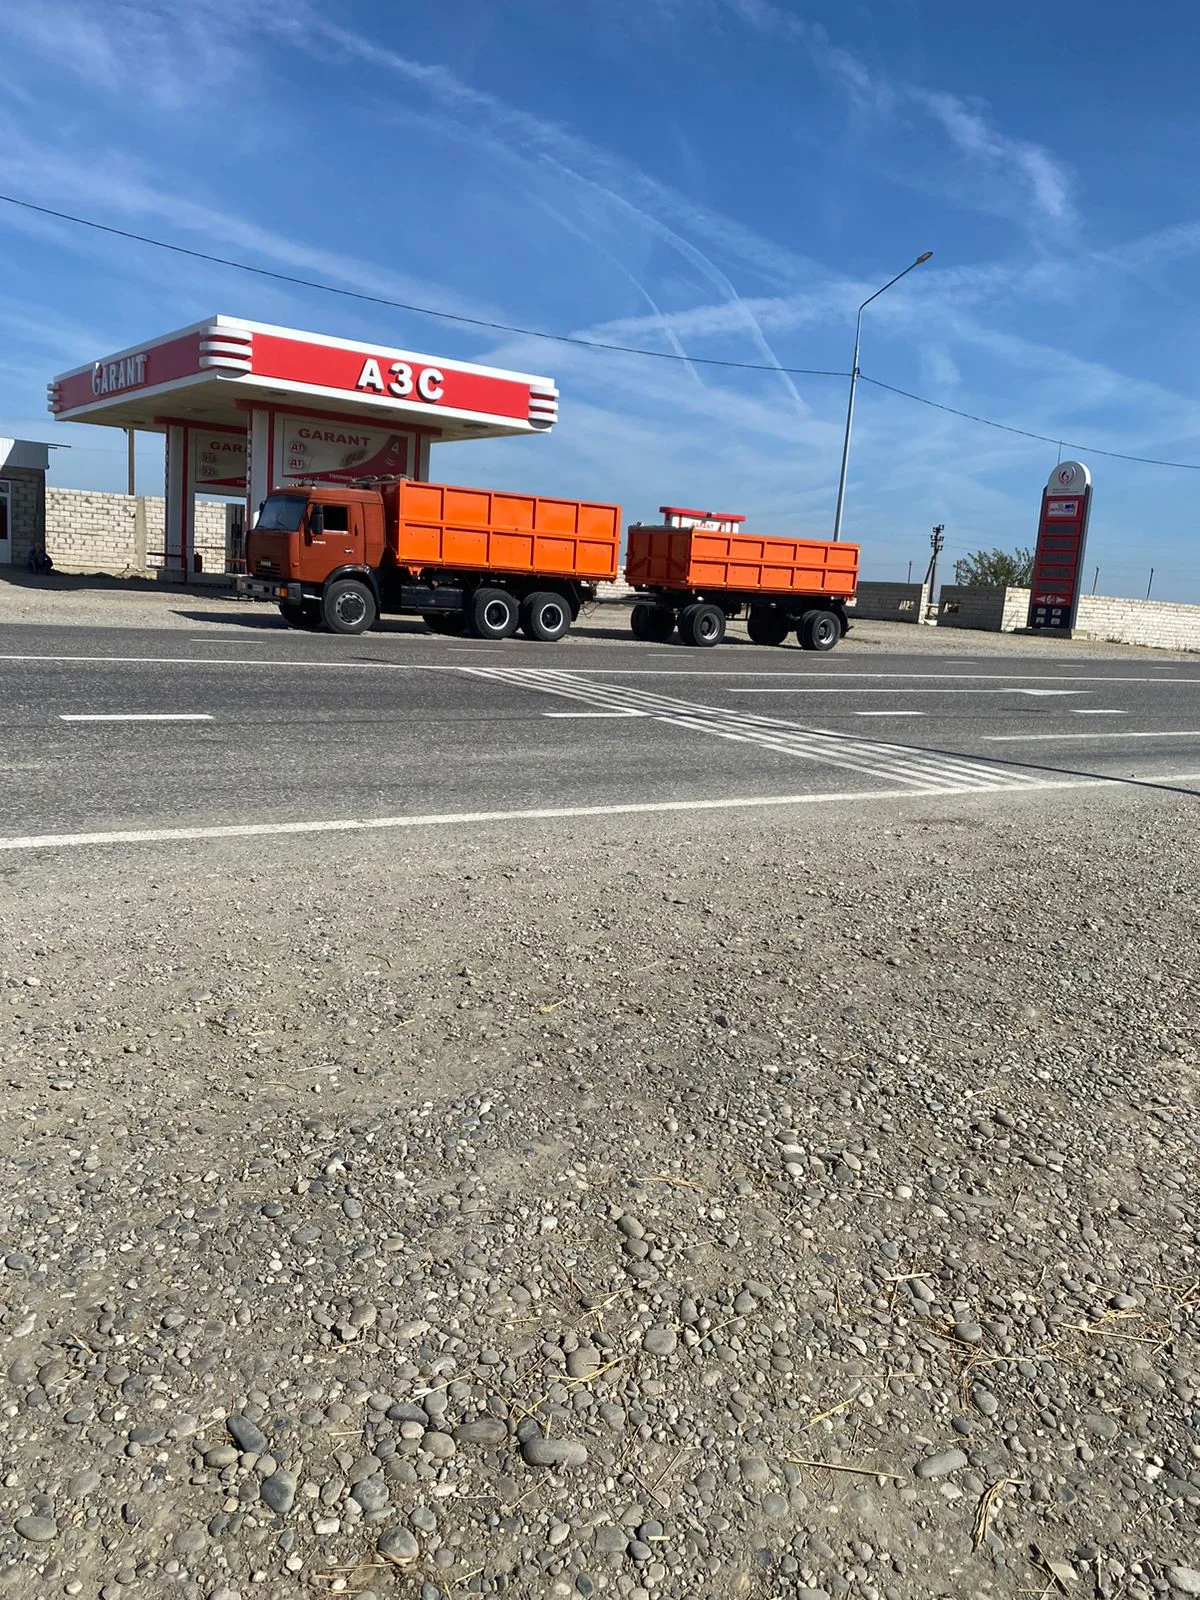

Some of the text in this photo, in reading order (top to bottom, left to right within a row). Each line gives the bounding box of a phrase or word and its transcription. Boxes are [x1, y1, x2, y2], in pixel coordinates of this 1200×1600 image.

[91, 354, 147, 396] GARANT
[356, 358, 445, 403] АЗС
[298, 428, 371, 447] GARANT
[391, 441, 400, 454] 4
